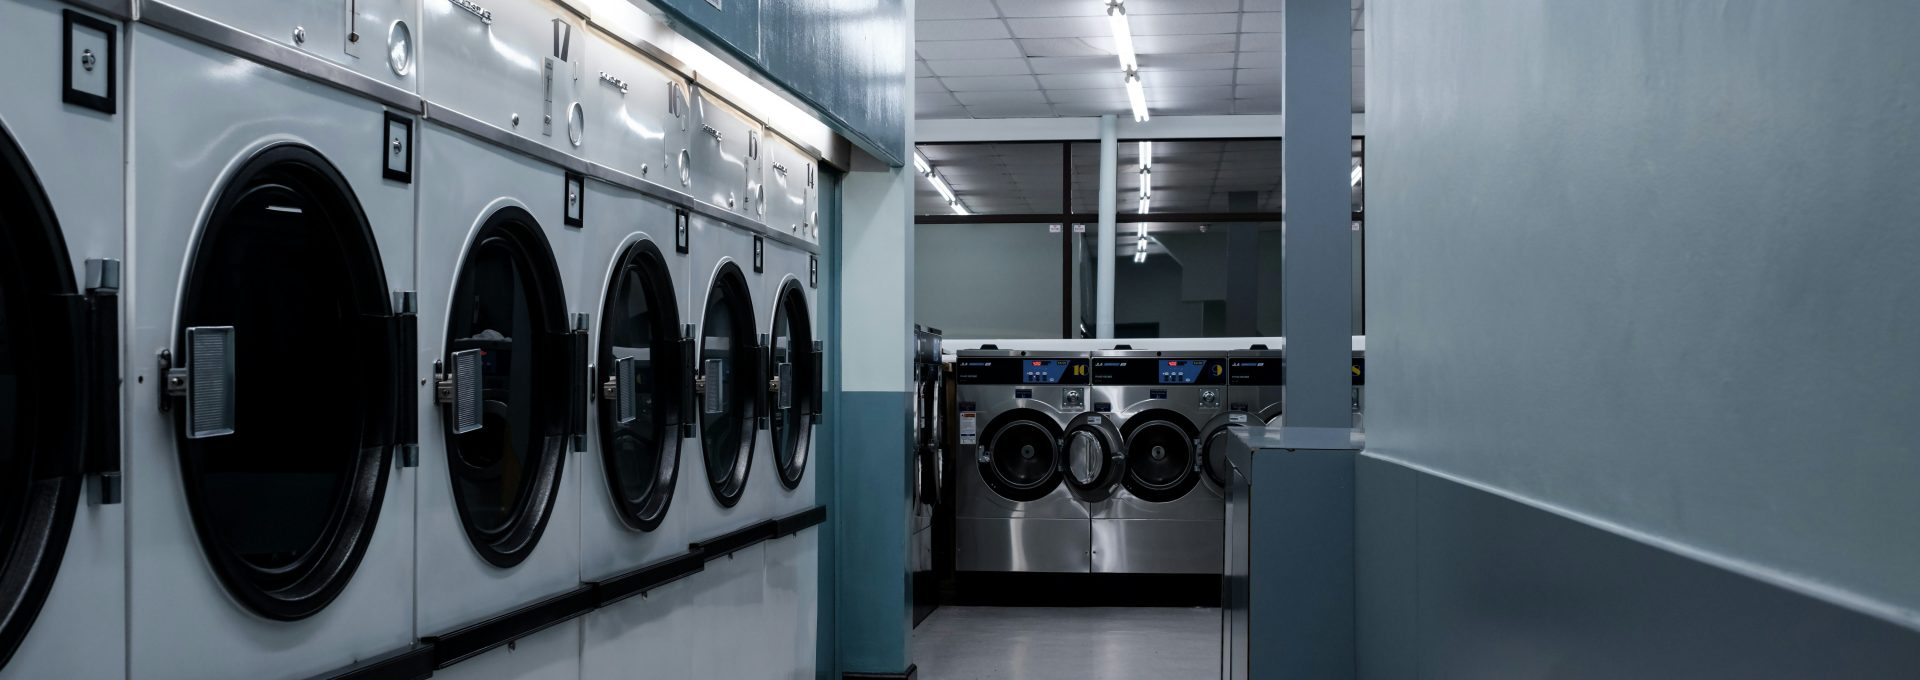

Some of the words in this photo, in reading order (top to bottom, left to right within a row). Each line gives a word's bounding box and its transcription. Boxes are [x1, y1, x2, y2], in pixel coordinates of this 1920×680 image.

[552, 18, 571, 62] 17
[667, 81, 681, 118] 16
[748, 130, 758, 160] 15
[806, 163, 814, 189] 14
[1071, 364, 1089, 376] 10
[1211, 363, 1223, 377] 9
